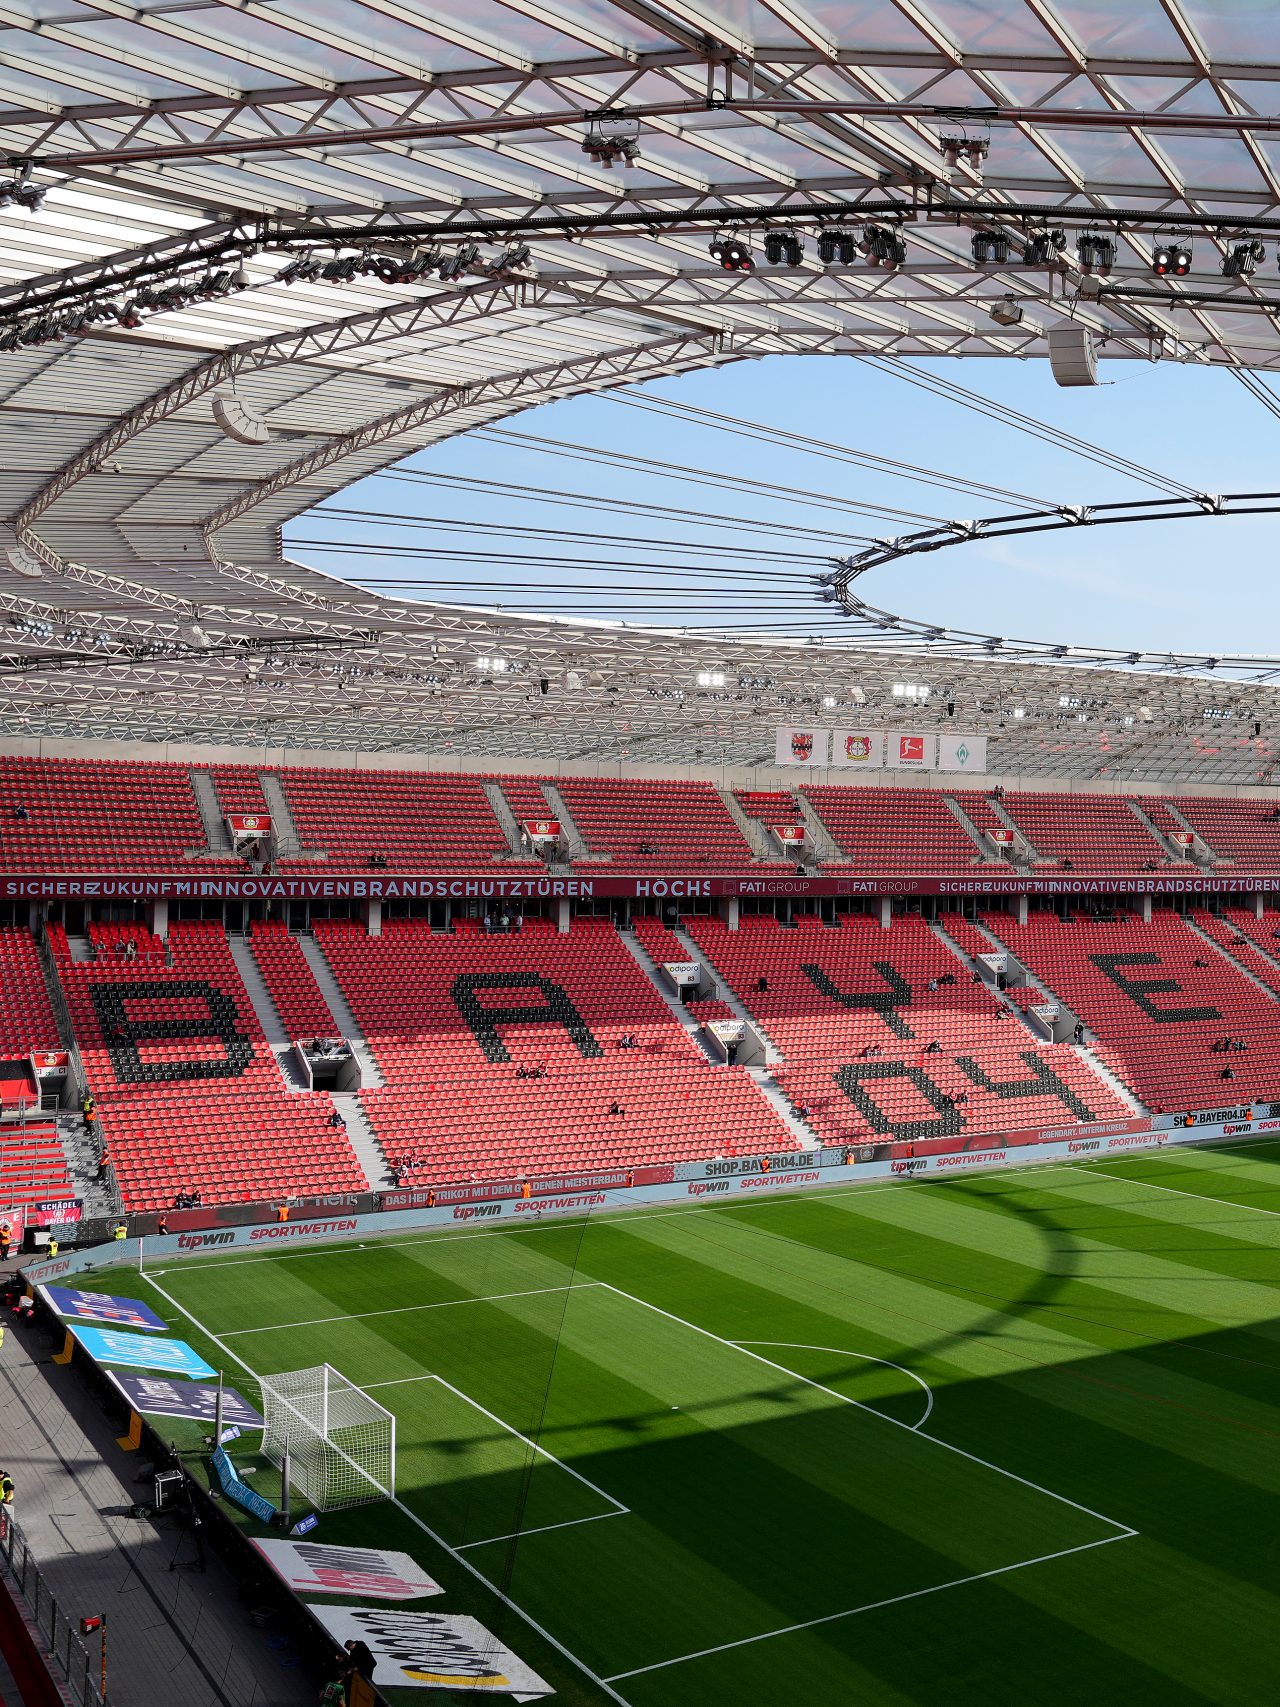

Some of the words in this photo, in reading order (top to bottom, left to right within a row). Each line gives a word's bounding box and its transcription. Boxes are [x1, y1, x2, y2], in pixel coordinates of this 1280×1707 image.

[353, 878, 594, 897] BRANDSCHUTZTÜREN
[740, 882, 767, 892] FATI
[768, 882, 810, 892] GROUP
[853, 881, 878, 892] FATI
[879, 881, 918, 892] GROUP
[1136, 877, 1280, 892] BRANDSCHUTZTÜREN
[1173, 1109, 1250, 1127] SHP.BAYER04.D
[1038, 1128, 1078, 1140] LEGENDARY.
[1078, 1125, 1105, 1136] UNTERM
[1105, 1122, 1129, 1134] KREUZ.
[1223, 1123, 1251, 1135] tipwin
[1068, 1140, 1100, 1153] tipwin
[1108, 1132, 1169, 1148] SPORTWETTEN
[890, 1159, 928, 1173] tipwin
[936, 1151, 1006, 1168] SPORTWETTEN
[385, 1195, 407, 1206] DAS
[408, 1188, 470, 1204] HEITRIKOT
[471, 1186, 490, 1197] MIT
[491, 1184, 513, 1195] DEM
[514, 1178, 564, 1194] GDENEN
[687, 1181, 730, 1196] tipwin
[740, 1171, 820, 1189] SPORTWETTEN
[41, 1201, 77, 1211] SCHÄDEL
[453, 1204, 502, 1220] tipwin
[513, 1194, 607, 1213] SPORTWETTEN
[178, 1231, 236, 1250] tipwin
[249, 1218, 358, 1240] SPORTWETTEN
